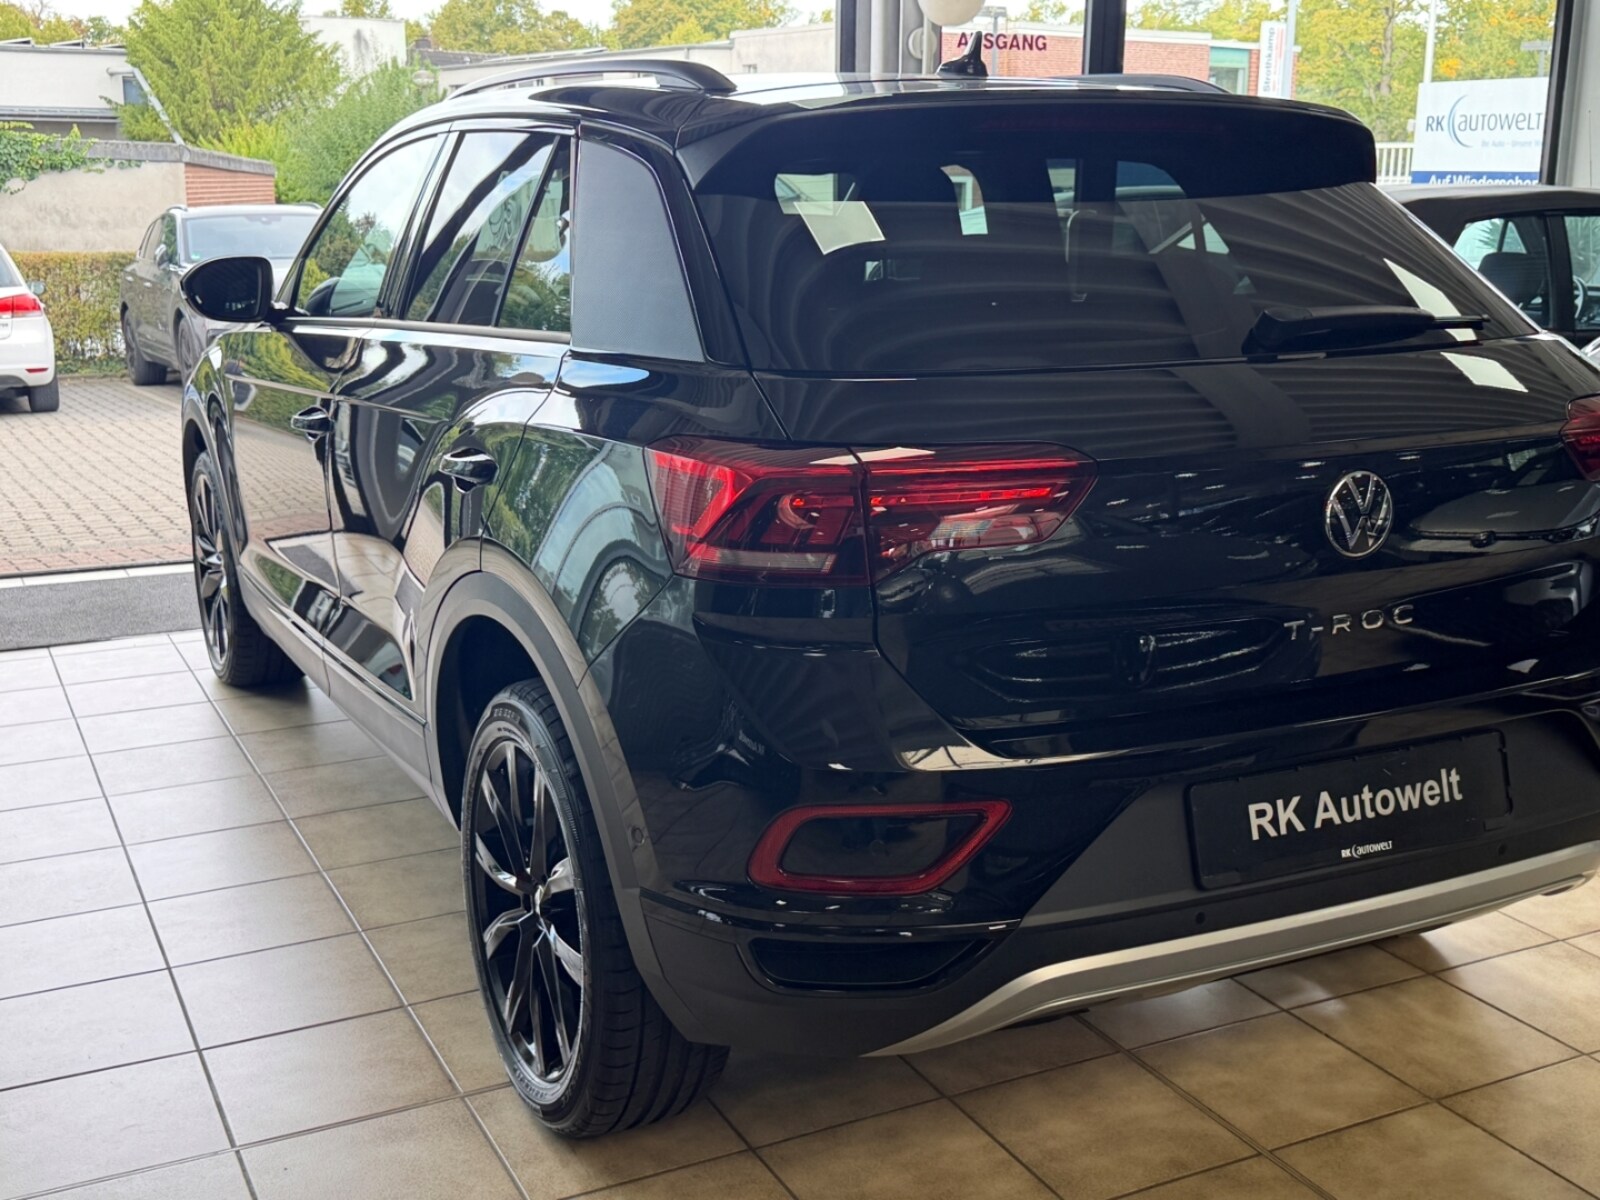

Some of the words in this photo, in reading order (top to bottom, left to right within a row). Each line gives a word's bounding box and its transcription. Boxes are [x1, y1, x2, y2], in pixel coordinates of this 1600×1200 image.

[957, 32, 1047, 51] ASGANG
[1425, 115, 1445, 132] RK
[1283, 604, 1415, 641] T-ROC
[1247, 795, 1306, 841] RK
[1314, 767, 1464, 829] Autowelt
